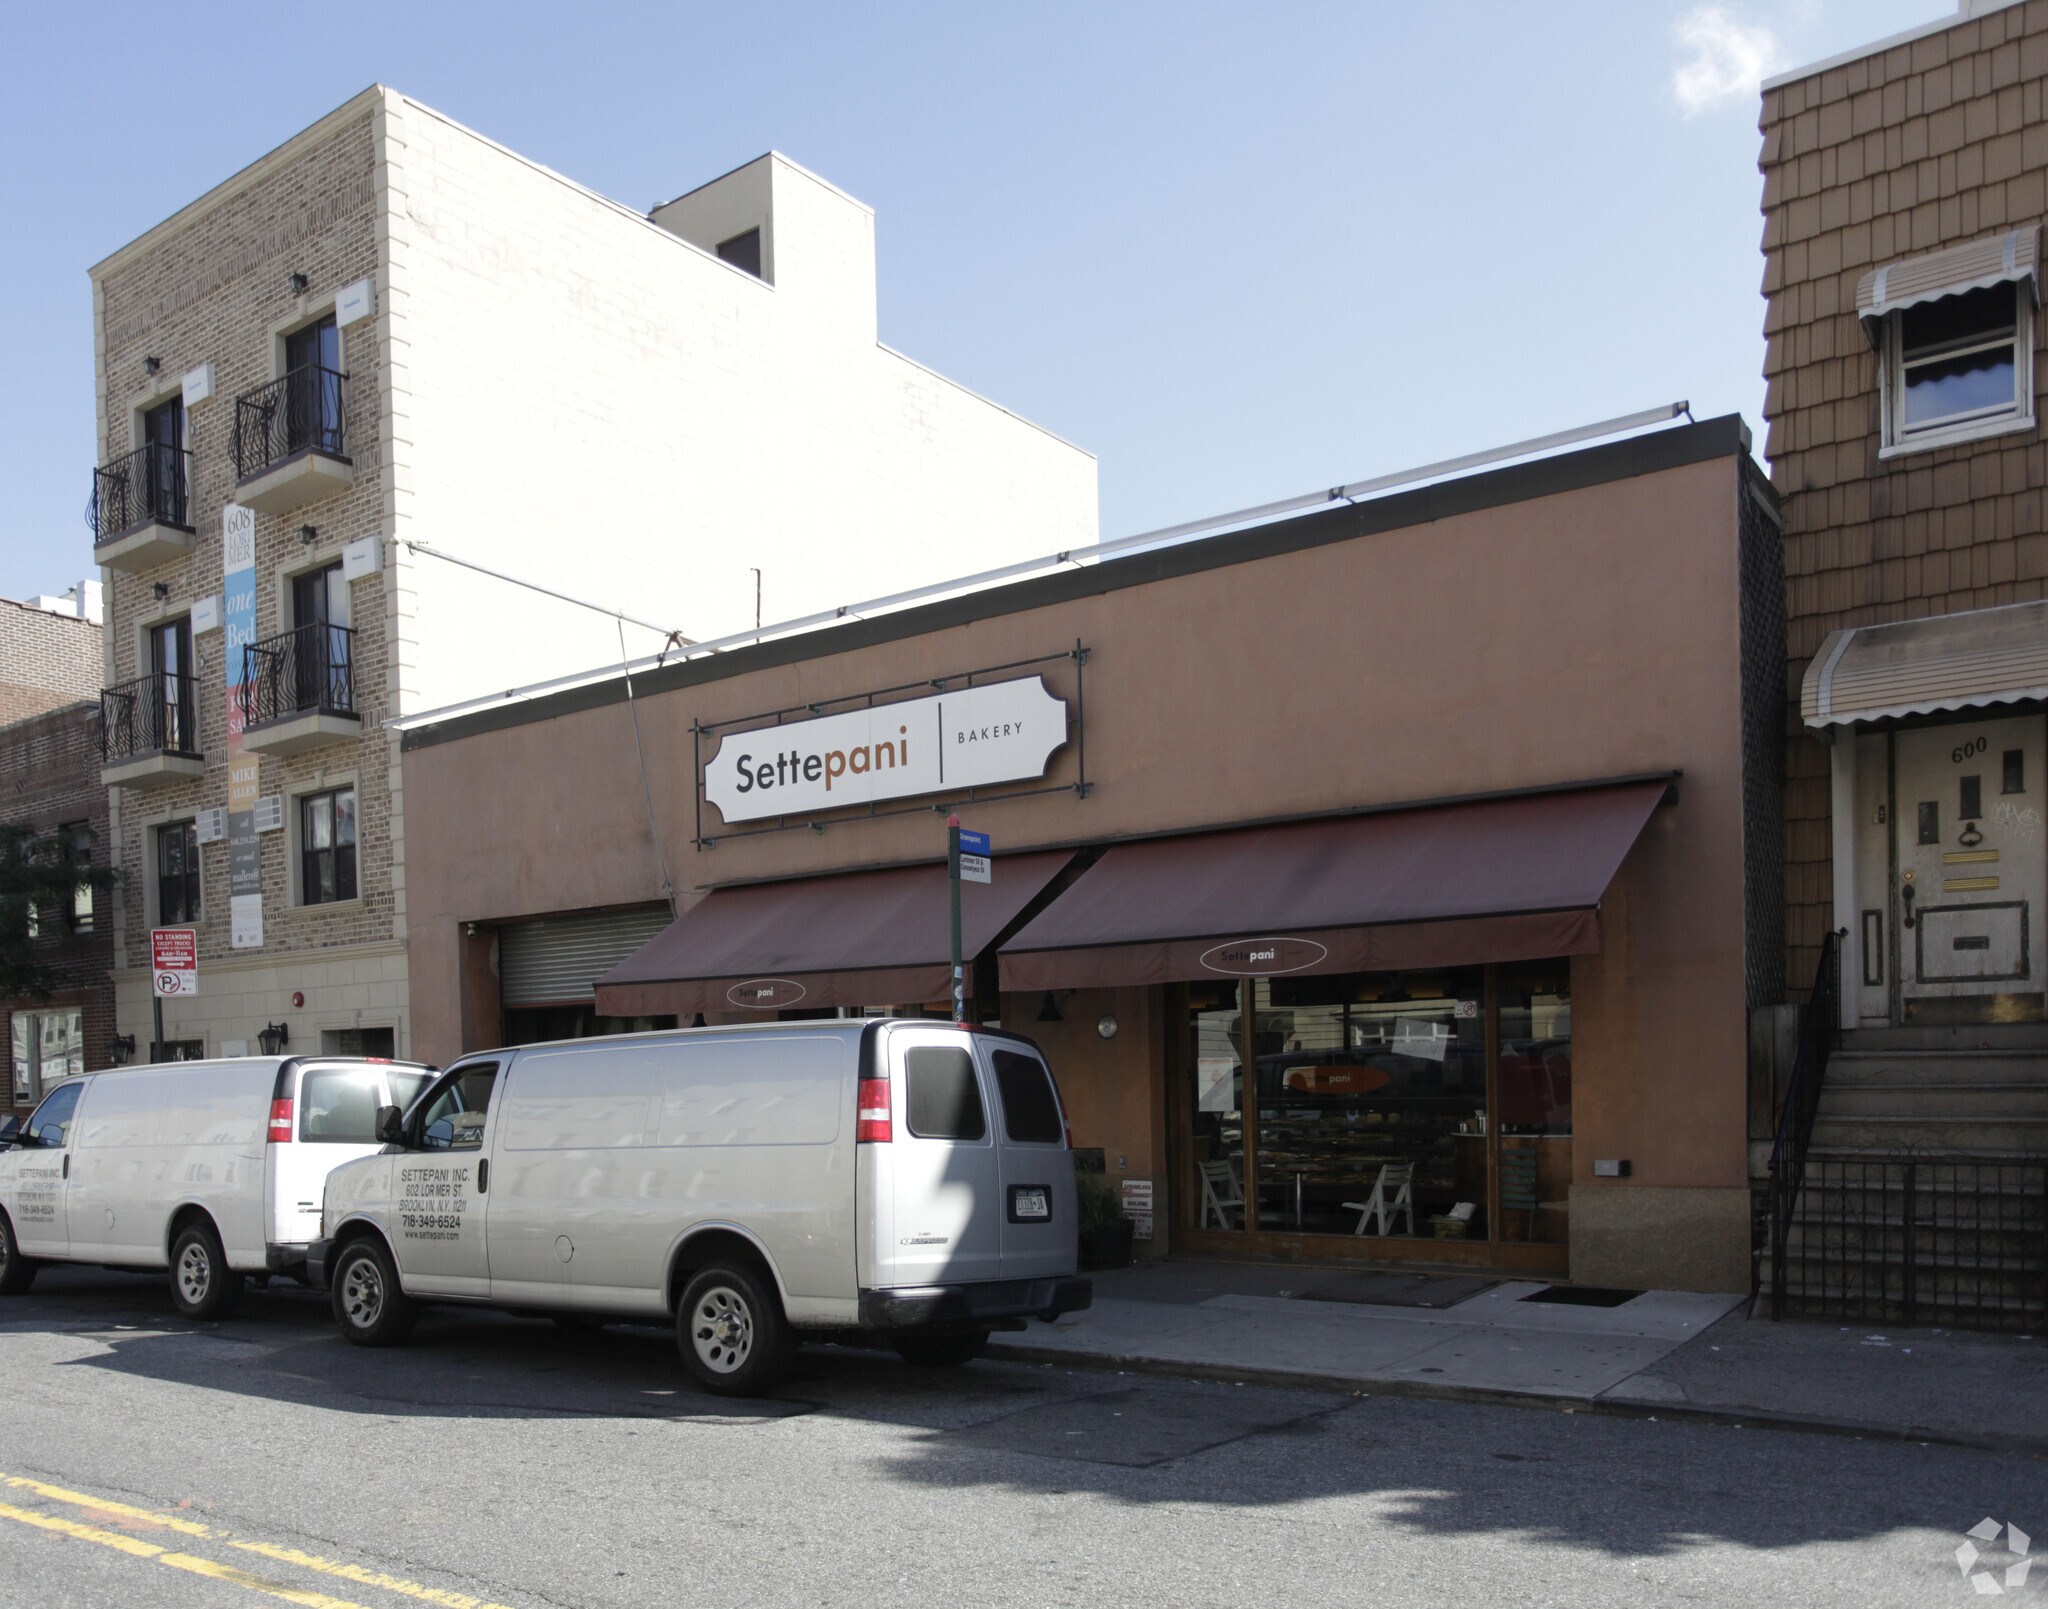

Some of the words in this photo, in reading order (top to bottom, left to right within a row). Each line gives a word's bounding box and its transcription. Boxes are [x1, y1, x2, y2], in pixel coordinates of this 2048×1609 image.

[228, 507, 251, 534] 608
[229, 530, 251, 549] LORI
[228, 544, 251, 566] MER
[227, 590, 254, 615] one
[227, 617, 255, 648] Bed
[736, 725, 908, 793] Settepani
[957, 722, 1023, 744] BAKERY
[1952, 736, 1987, 763] 600
[231, 767, 257, 784] MIKE
[232, 785, 257, 799] ALLEN
[1221, 948, 1275, 963] Settepani
[739, 987, 774, 999] Settepani
[401, 1168, 449, 1182] SETTEPANI
[452, 1168, 470, 1182] INC.
[405, 1184, 419, 1197] 602
[453, 1184, 463, 1197] ST.
[399, 1199, 434, 1213] BROOKLYN,
[437, 1200, 450, 1212] N.Y.
[452, 1200, 467, 1213] 11211
[402, 1214, 461, 1229] 718-349-6524
[405, 1231, 459, 1241] www.settepani.com
